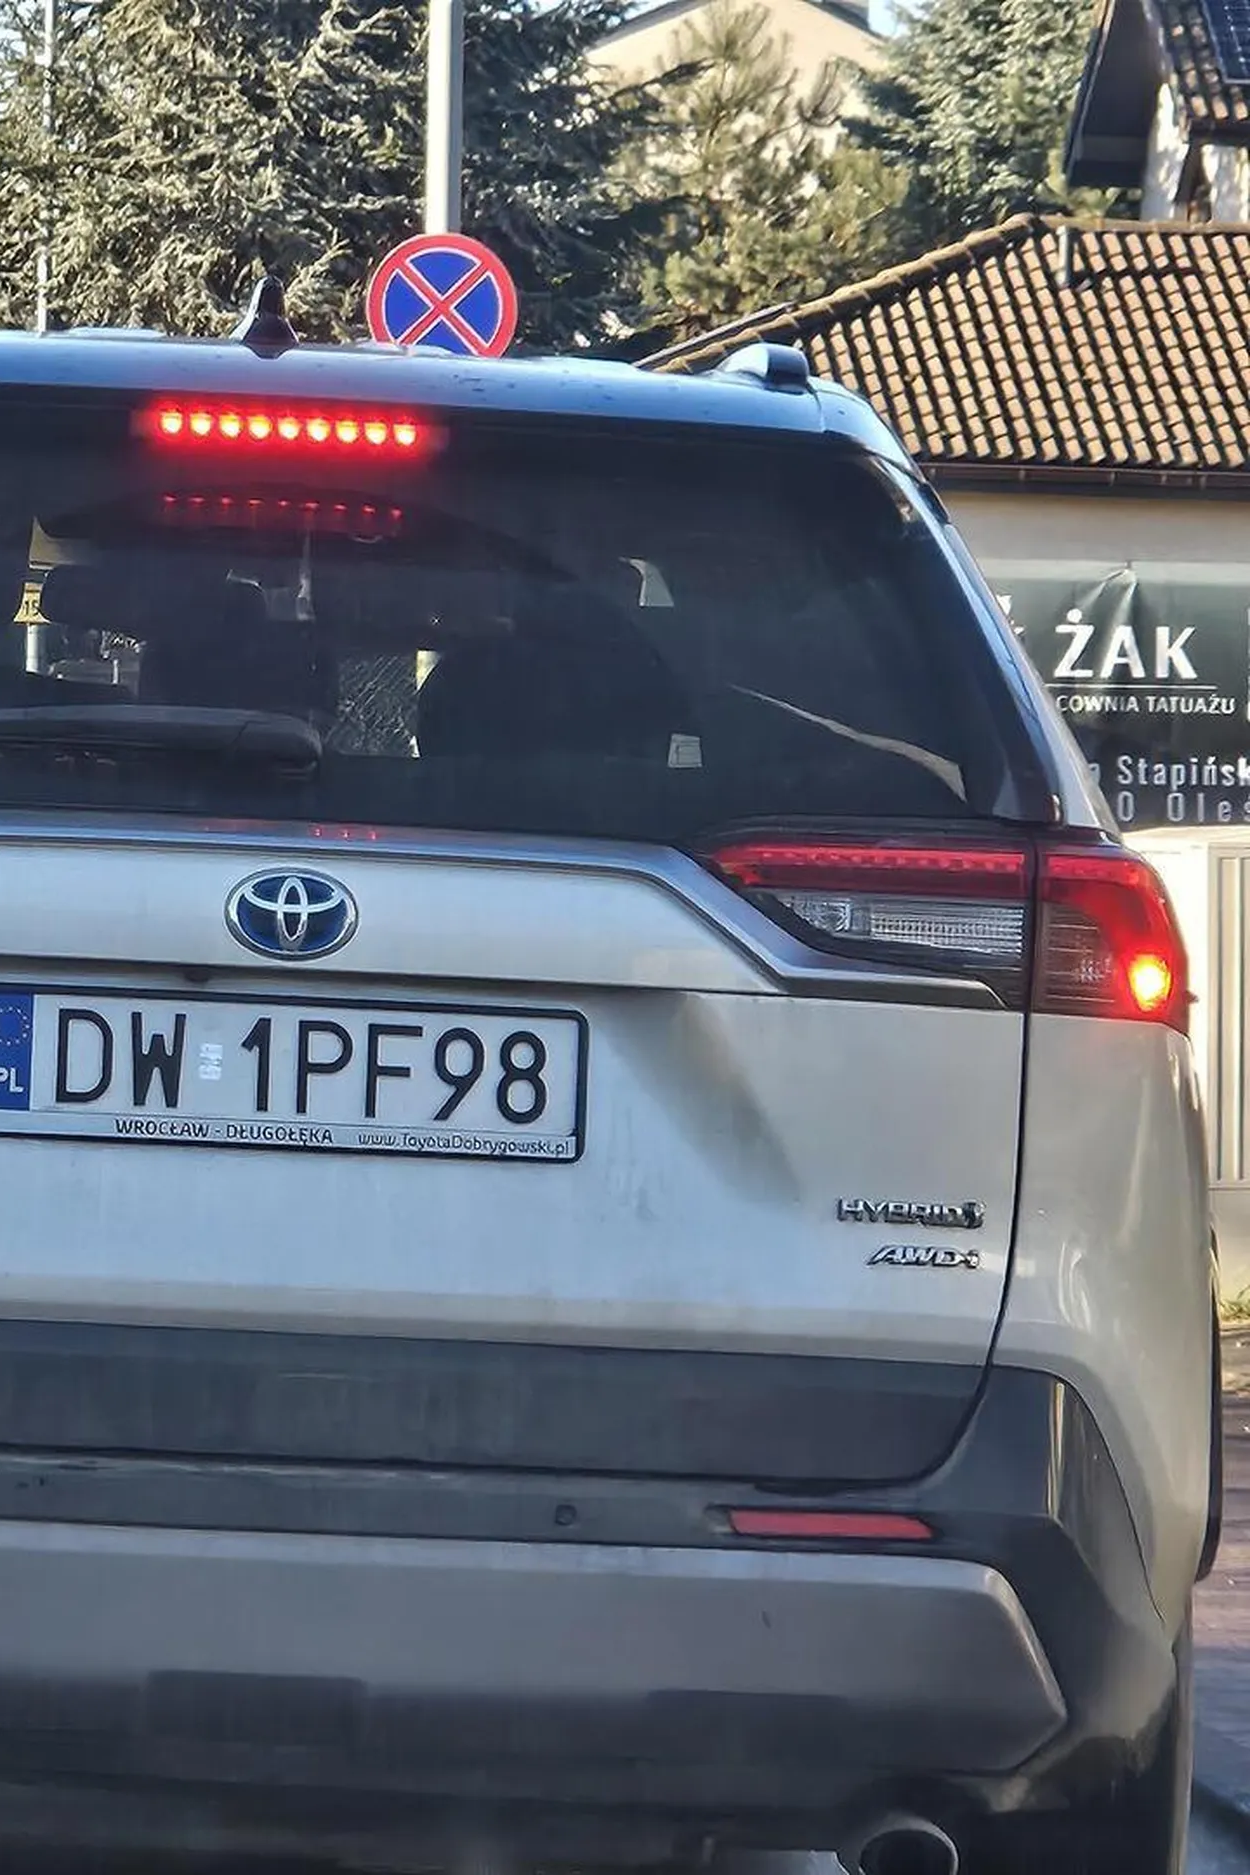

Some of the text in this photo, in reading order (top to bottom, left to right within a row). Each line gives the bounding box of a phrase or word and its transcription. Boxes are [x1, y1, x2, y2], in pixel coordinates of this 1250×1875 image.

[1054, 608, 1197, 678] ŻAK
[55, 1008, 547, 1125] DW 1PF98
[116, 1118, 210, 1138] WROCŁAW
[226, 1124, 334, 1145] DŁUGOŁĘKA
[837, 1198, 964, 1227] HYBRID
